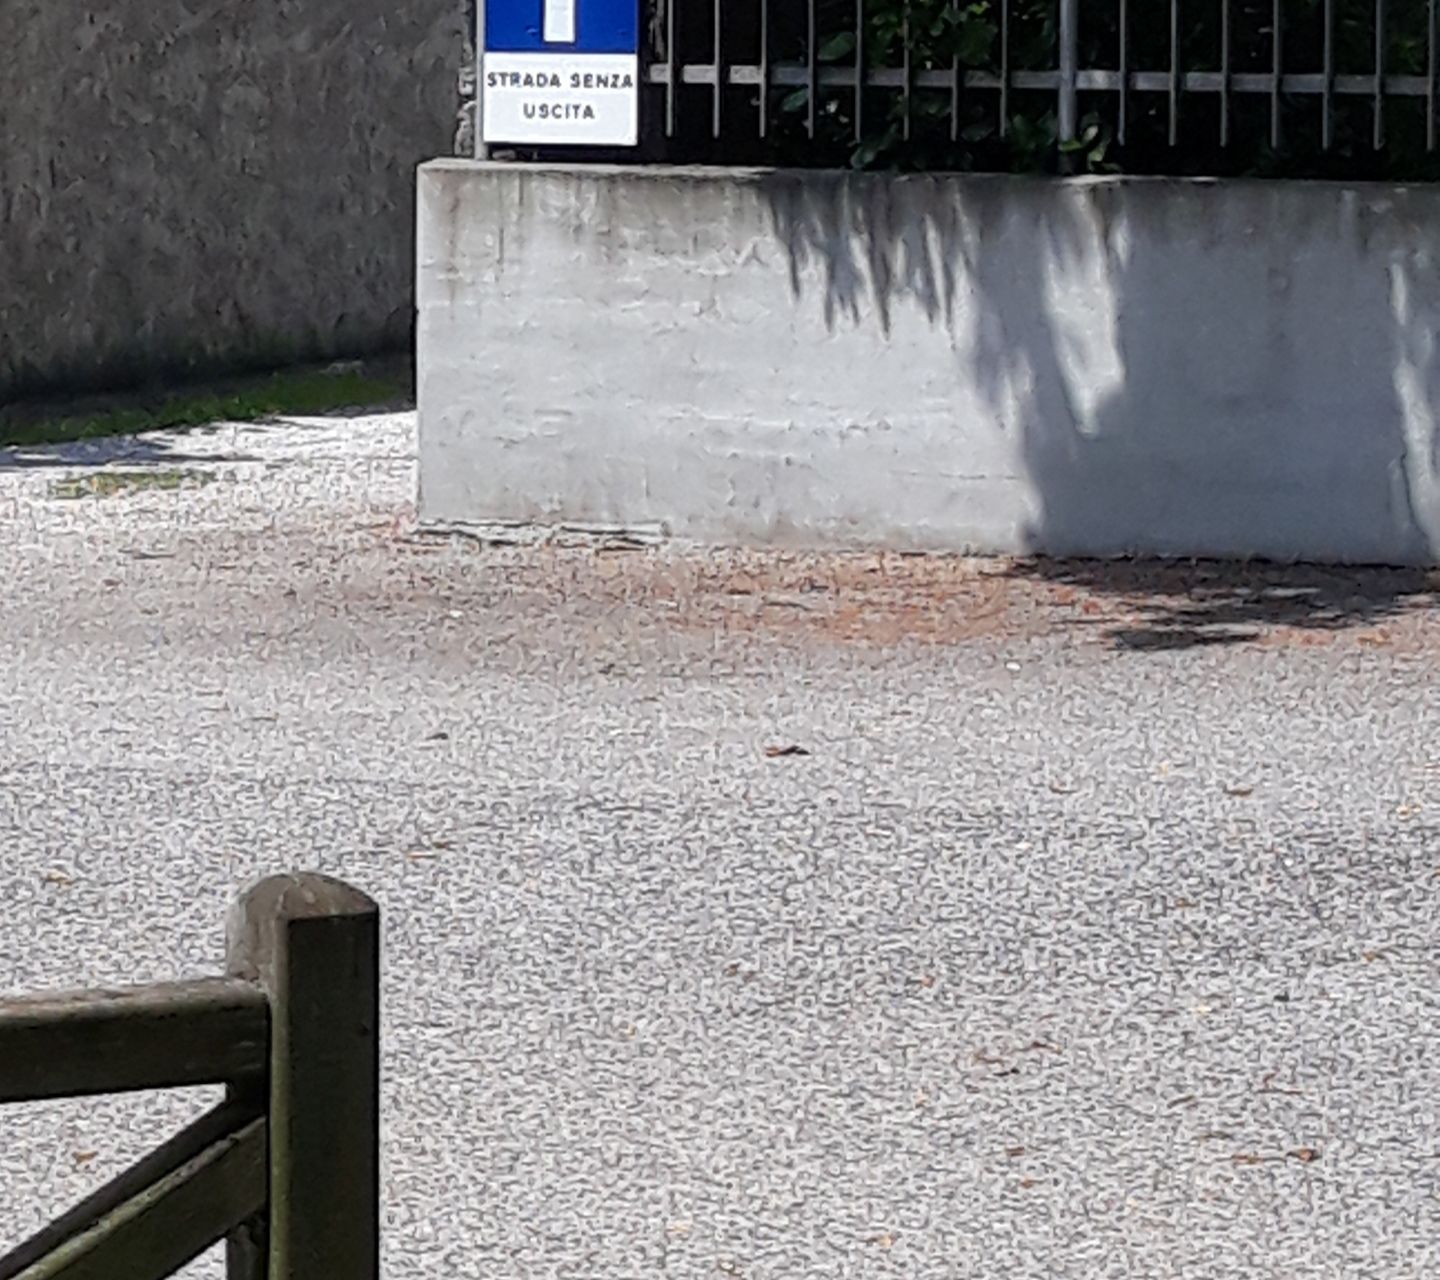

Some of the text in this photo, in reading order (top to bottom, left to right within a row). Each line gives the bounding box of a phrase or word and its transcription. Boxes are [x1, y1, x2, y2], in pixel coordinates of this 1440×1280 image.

[487, 72, 633, 88] STRADA SENZA
[524, 103, 594, 120] USCITA
